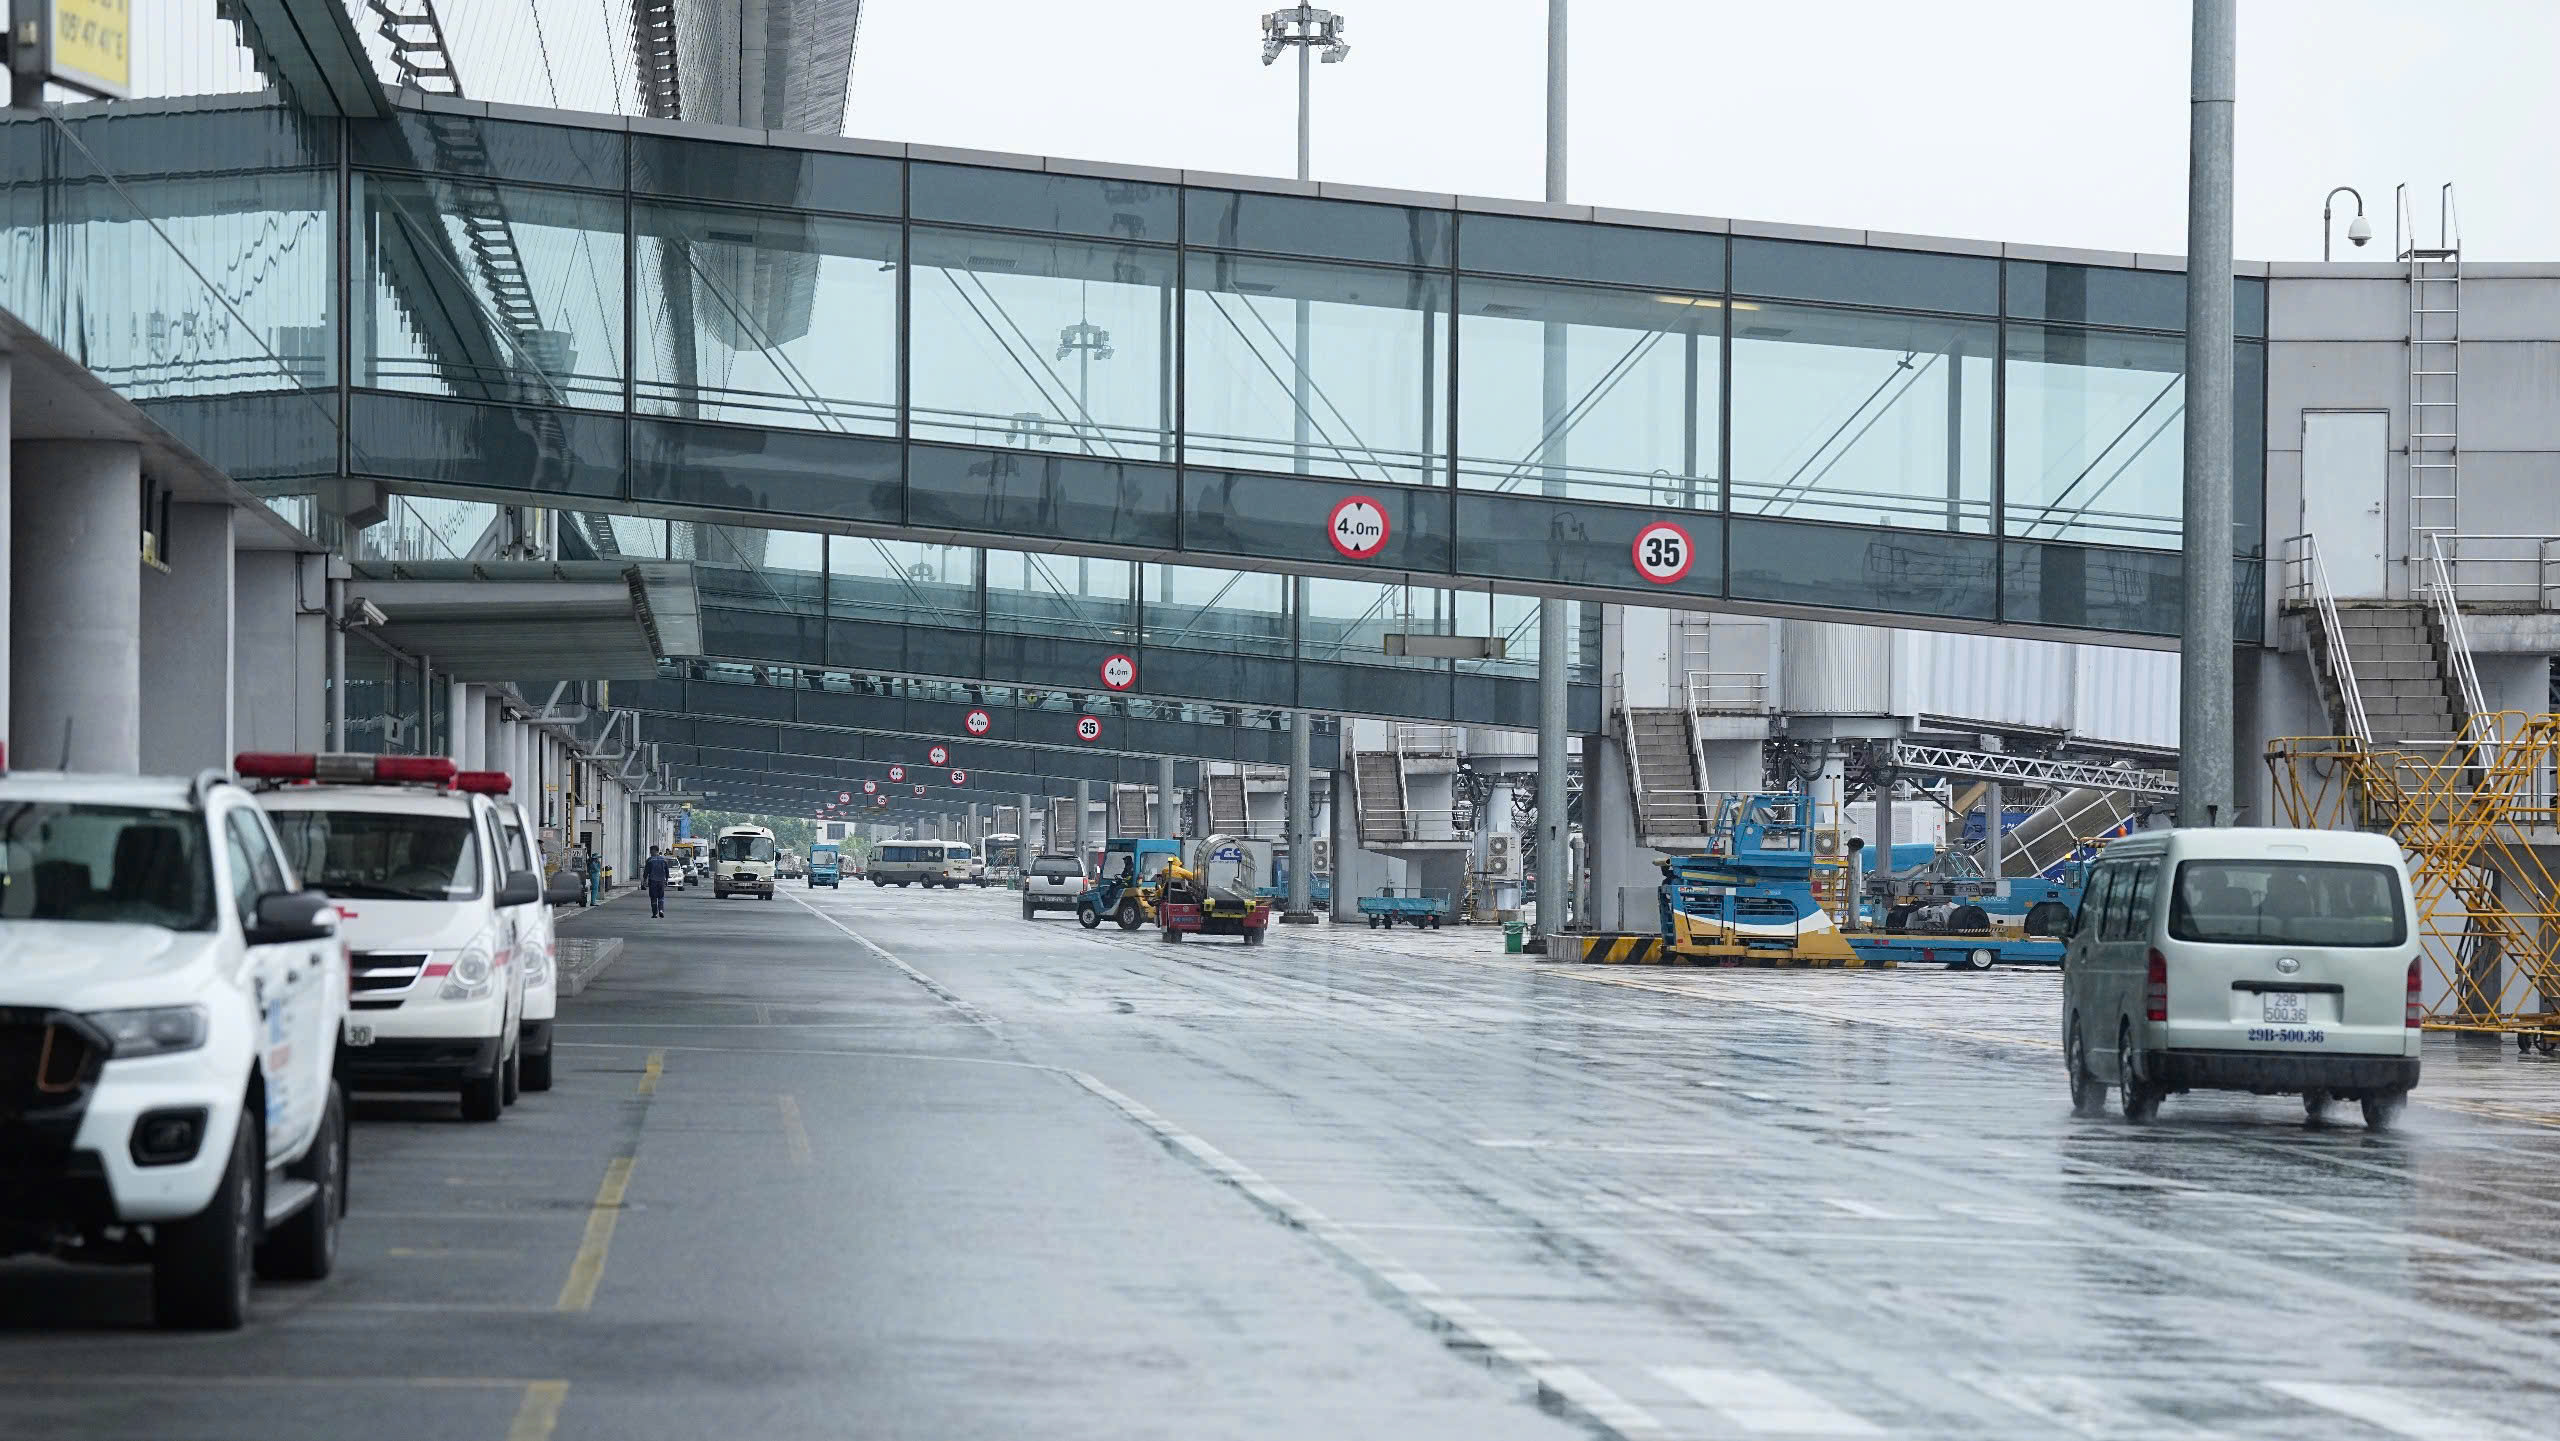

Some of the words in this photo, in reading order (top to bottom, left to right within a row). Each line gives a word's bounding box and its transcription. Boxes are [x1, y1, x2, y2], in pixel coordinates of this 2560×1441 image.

[1337, 517, 1379, 536] 4.0m
[1646, 538, 1680, 567] 35
[1108, 667, 1128, 676] 4.0m
[969, 718, 986, 726] 4.0m
[1081, 722, 1096, 735] 35
[953, 773, 963, 781] 35
[2275, 993, 2298, 1007] 29B
[2266, 1008, 2305, 1021] 500.36
[2248, 1029, 2324, 1043] 29B-500.36
